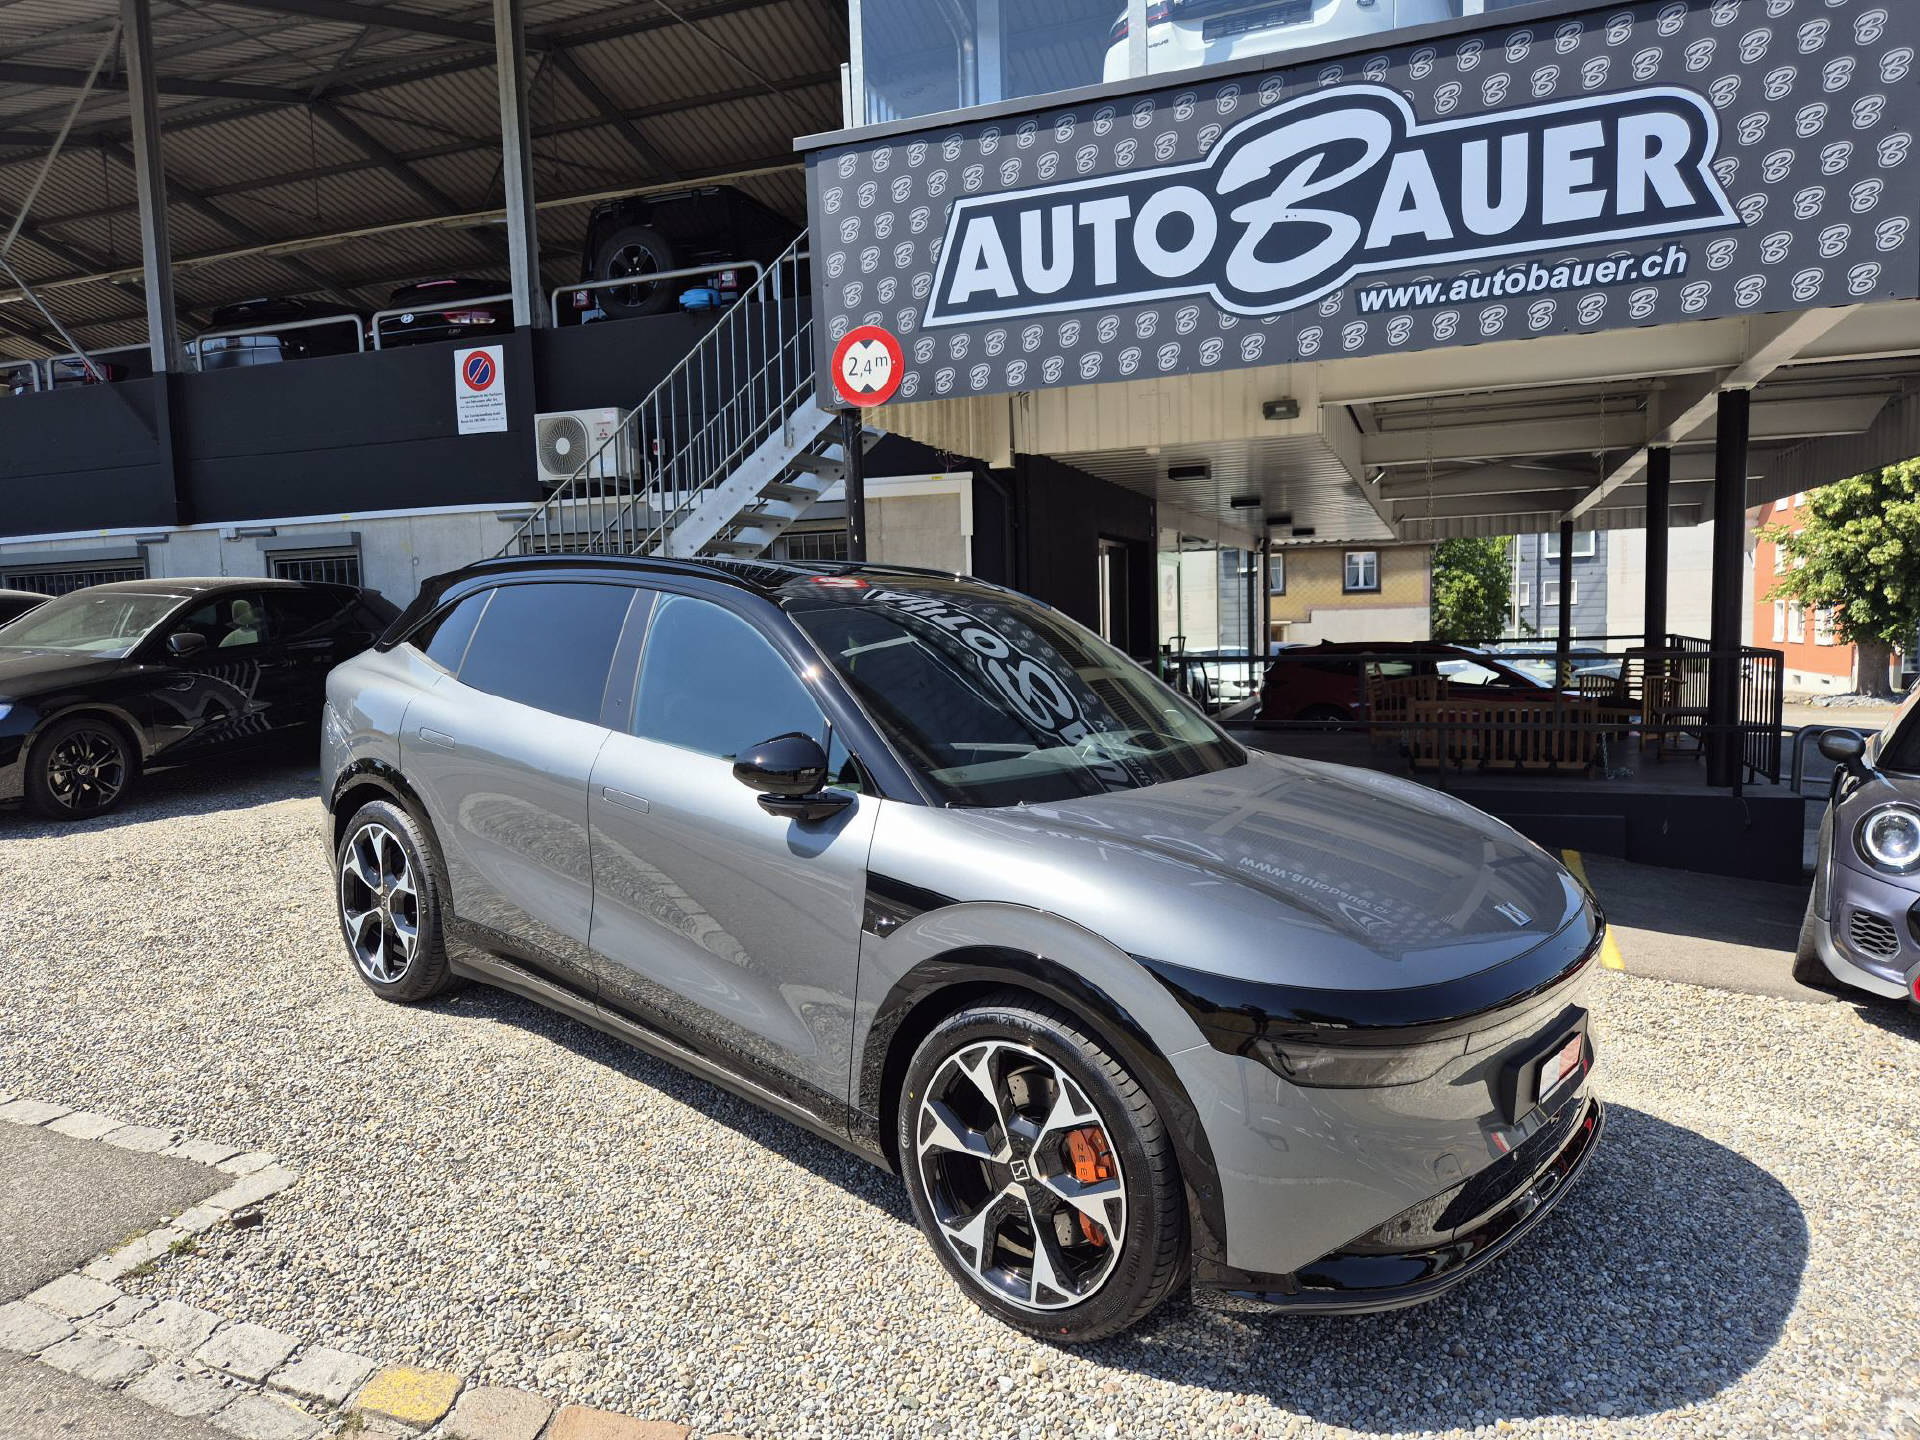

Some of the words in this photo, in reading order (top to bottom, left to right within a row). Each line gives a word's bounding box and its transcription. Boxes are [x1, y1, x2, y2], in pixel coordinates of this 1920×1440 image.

[1605, 12, 1635, 46] B
[1654, 3, 1688, 36] B
[1855, 9, 1887, 44] B
[1505, 30, 1533, 64] B
[1554, 21, 1584, 54] B
[1740, 29, 1771, 63] B
[1798, 19, 1829, 53] B
[1364, 57, 1388, 81] B
[1409, 47, 1437, 80] B
[1456, 39, 1485, 72] B
[1633, 48, 1662, 80] B
[1685, 39, 1716, 71] B
[1880, 48, 1913, 82] B
[1532, 66, 1559, 96] B
[1582, 57, 1609, 89] B
[1765, 67, 1796, 100] B
[1823, 57, 1855, 91] B
[1216, 84, 1241, 114] B
[1257, 76, 1282, 107] B
[1435, 82, 1461, 114] B
[1483, 73, 1509, 105] B
[1710, 75, 1740, 108] B
[1093, 106, 1116, 136] B
[1132, 98, 1156, 129] B
[1173, 92, 1197, 121] B
[1796, 103, 1827, 137] B
[1852, 95, 1886, 128] B
[979, 127, 1001, 155] B
[1017, 120, 1038, 149] B
[1054, 113, 1077, 143] B
[1738, 113, 1769, 144] B
[870, 146, 893, 173] B
[906, 142, 928, 167] B
[941, 134, 963, 161] B
[1077, 145, 1097, 173] B
[1115, 139, 1136, 167] B
[1155, 132, 1177, 160] B
[1821, 142, 1852, 174] B
[1878, 133, 1911, 167] B
[838, 152, 858, 179] B
[963, 165, 983, 191] B
[1001, 159, 1021, 185] B
[1038, 152, 1058, 179] B
[1763, 149, 1794, 182] B
[858, 182, 876, 207] B
[892, 176, 911, 202] B
[928, 170, 947, 196] B
[1850, 179, 1883, 212] B
[824, 187, 843, 214] B
[1737, 194, 1767, 225] B
[1794, 187, 1825, 219] B
[841, 217, 860, 242] B
[875, 213, 893, 238] B
[910, 207, 929, 233] B
[1876, 217, 1910, 250] B
[895, 242, 913, 267] B
[1706, 239, 1736, 270] B
[1761, 232, 1792, 263] B
[1819, 225, 1850, 257] B
[827, 252, 846, 278] B
[861, 247, 879, 272] B
[878, 278, 896, 303] B
[913, 273, 931, 298] B
[1360, 244, 1687, 312] www.autobauer.ch
[1735, 275, 1765, 307] B
[1792, 268, 1823, 301] B
[1848, 263, 1880, 294] B
[843, 283, 862, 307] B
[1578, 293, 1606, 324] B
[1629, 288, 1657, 318] B
[1681, 282, 1711, 312] B
[830, 315, 849, 341] B
[898, 308, 916, 333] B
[1098, 316, 1119, 342] B
[1136, 312, 1158, 338] B
[1176, 306, 1198, 334] B
[1433, 311, 1459, 339] B
[1480, 306, 1506, 335] B
[1528, 300, 1556, 330] B
[986, 330, 1006, 355] B
[1023, 326, 1042, 351] B
[1059, 321, 1079, 347] B
[1298, 327, 1322, 355] B
[1343, 321, 1367, 350] B
[1387, 316, 1412, 345] B
[915, 338, 934, 363] B
[950, 335, 969, 359] B
[1119, 348, 1140, 374] B
[1158, 343, 1180, 370] B
[1200, 338, 1222, 365] B
[1242, 334, 1264, 360] B
[970, 364, 990, 389] B
[1007, 360, 1026, 385] B
[1043, 357, 1063, 382] B
[1081, 352, 1102, 378] B
[902, 372, 919, 396] B
[936, 368, 954, 393] B
